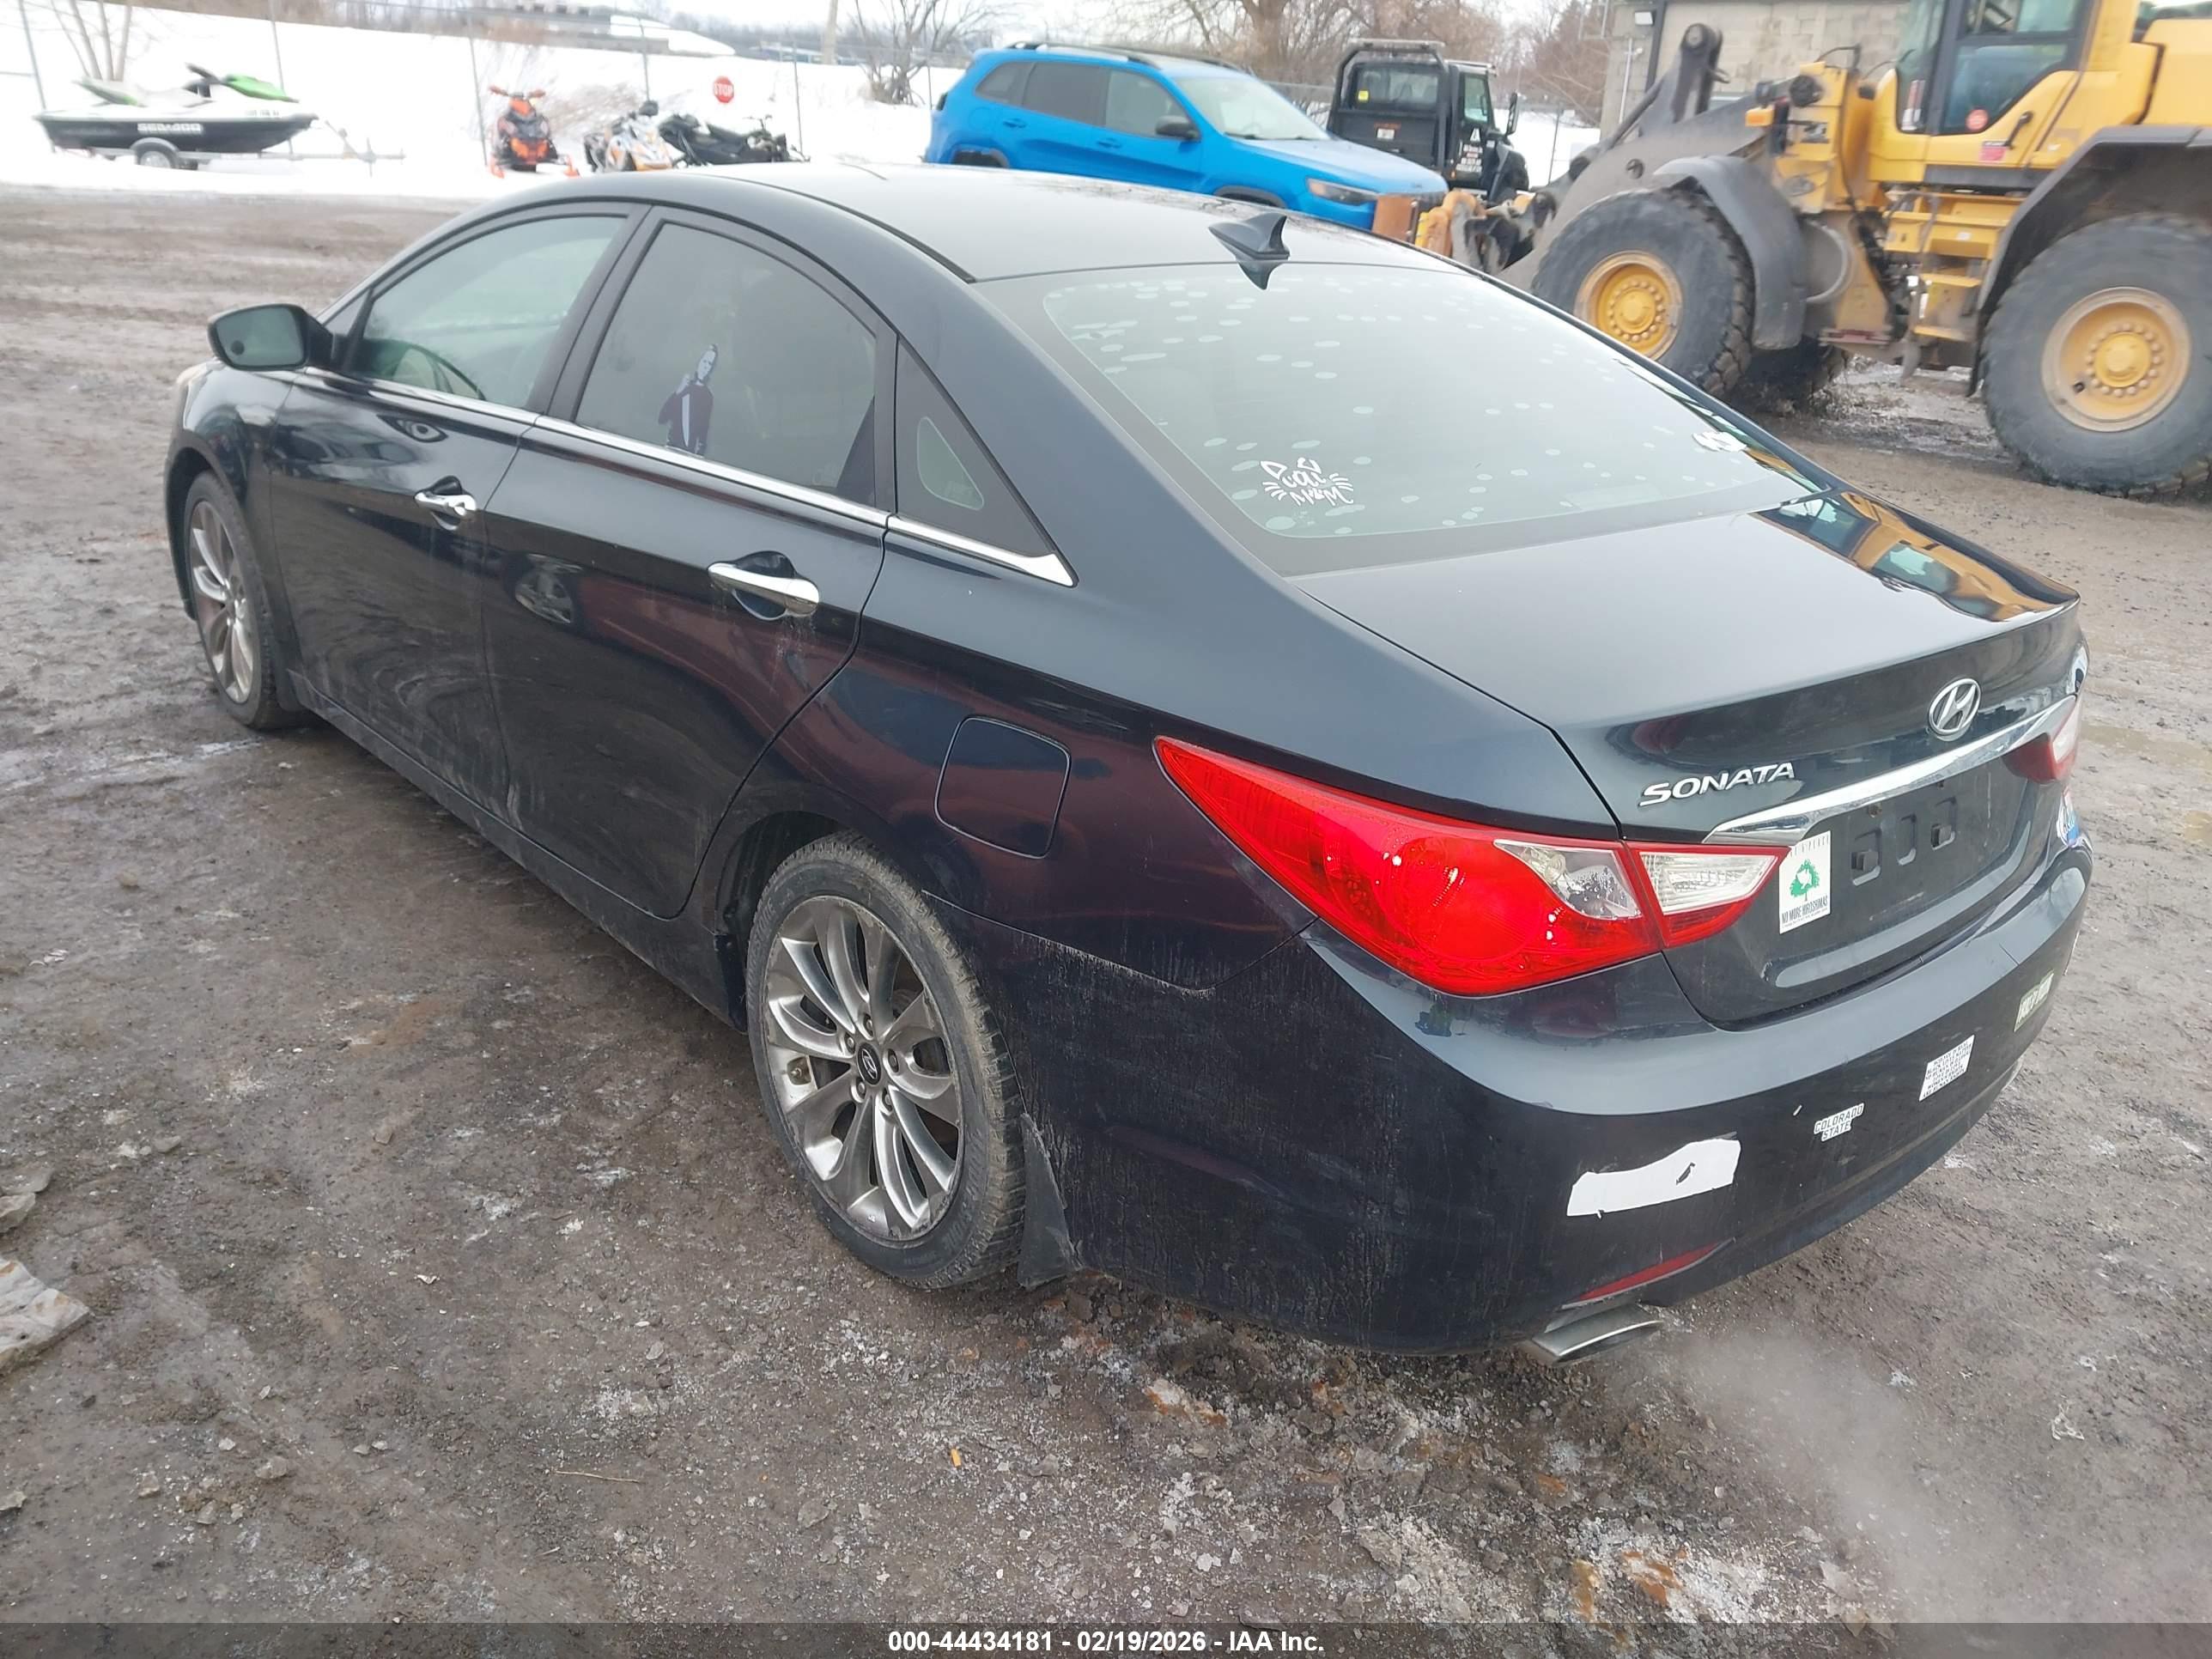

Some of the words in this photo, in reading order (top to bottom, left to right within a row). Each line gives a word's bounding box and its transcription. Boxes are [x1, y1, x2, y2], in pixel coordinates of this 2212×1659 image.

[714, 83, 733, 96] STOP
[1639, 762, 1796, 806] SONATA
[1814, 1105, 1863, 1133] COLORADO
[1823, 1121, 1850, 1139] STATE
